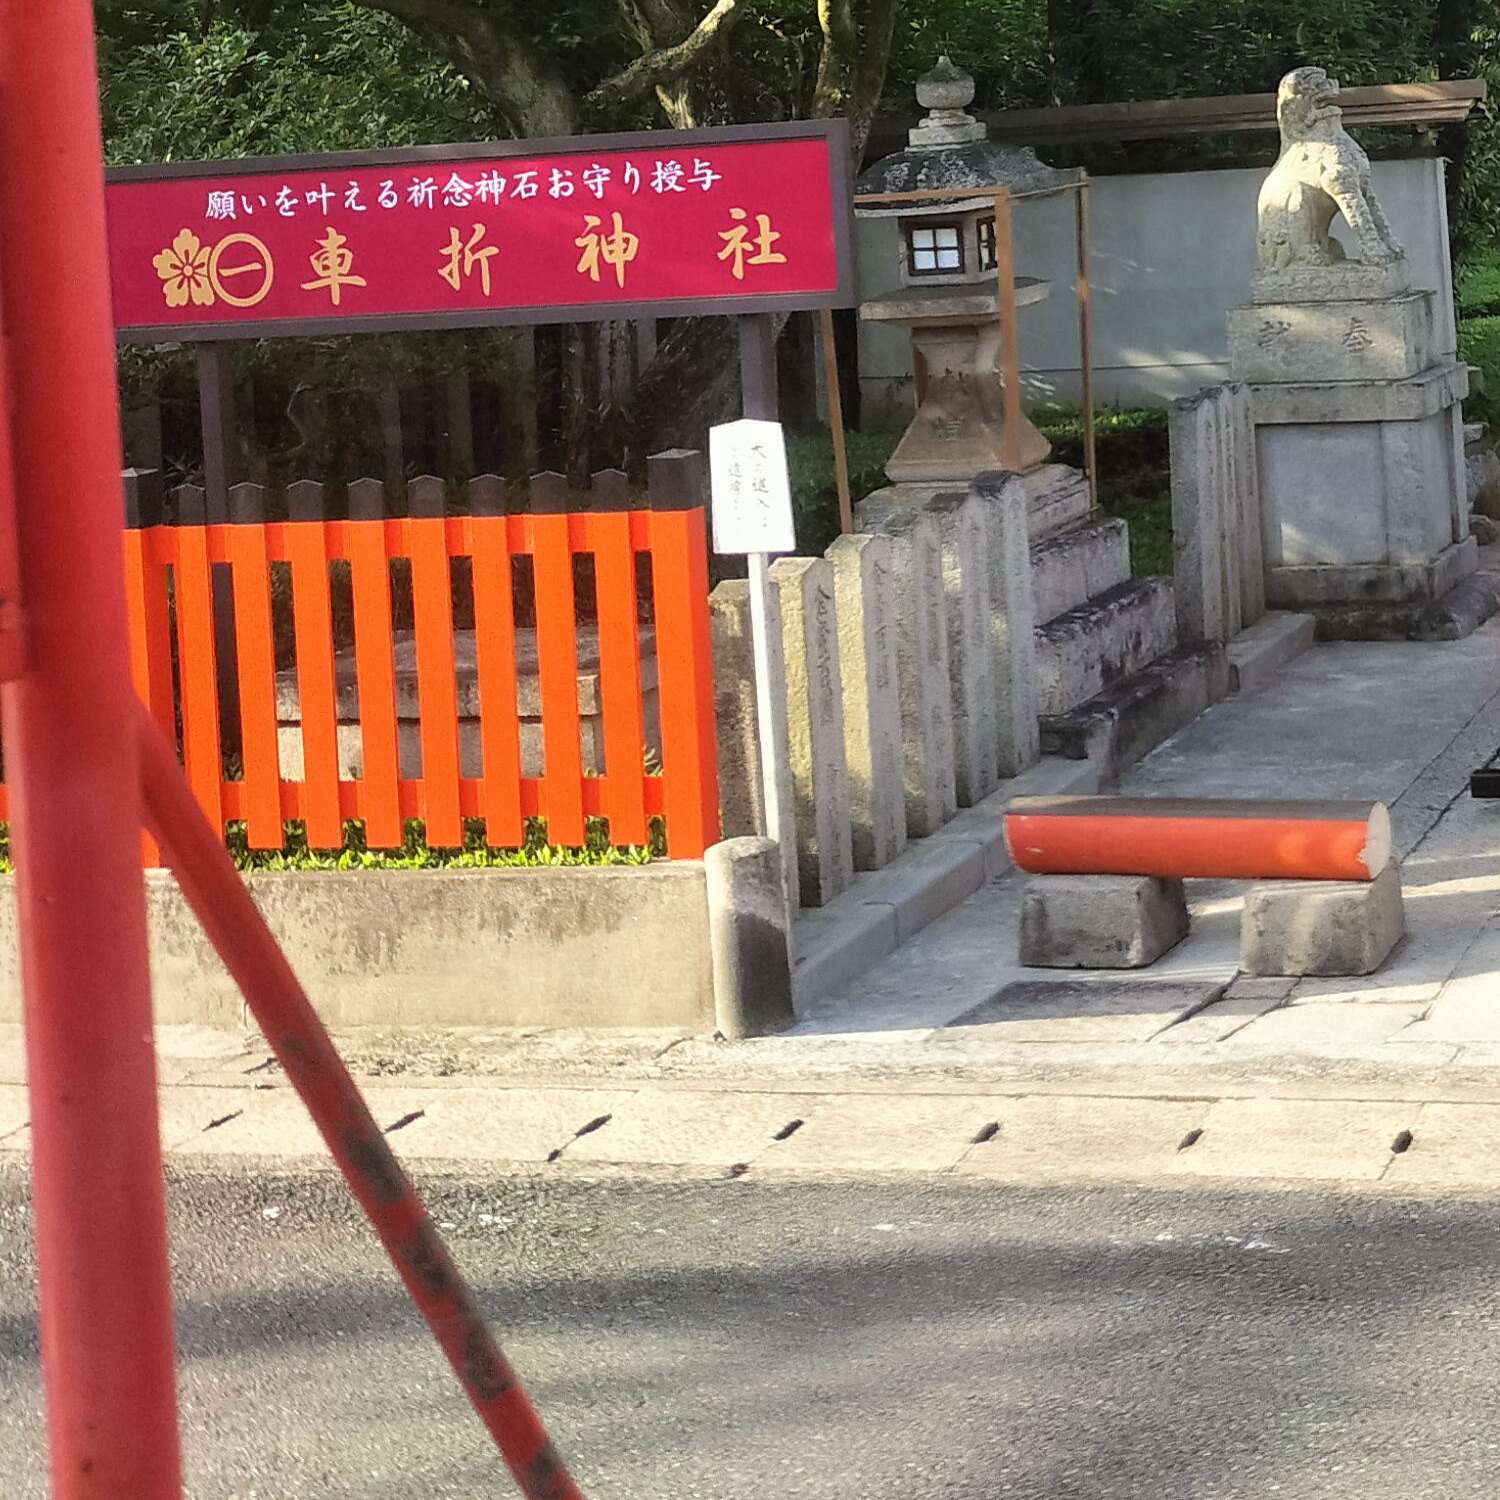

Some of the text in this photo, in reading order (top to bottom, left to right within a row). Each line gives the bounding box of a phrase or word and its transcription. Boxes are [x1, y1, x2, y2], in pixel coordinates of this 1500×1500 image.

[204, 157, 724, 221] 願いを叶える祈念神石お守り授与
[301, 207, 788, 306] 車折神社
